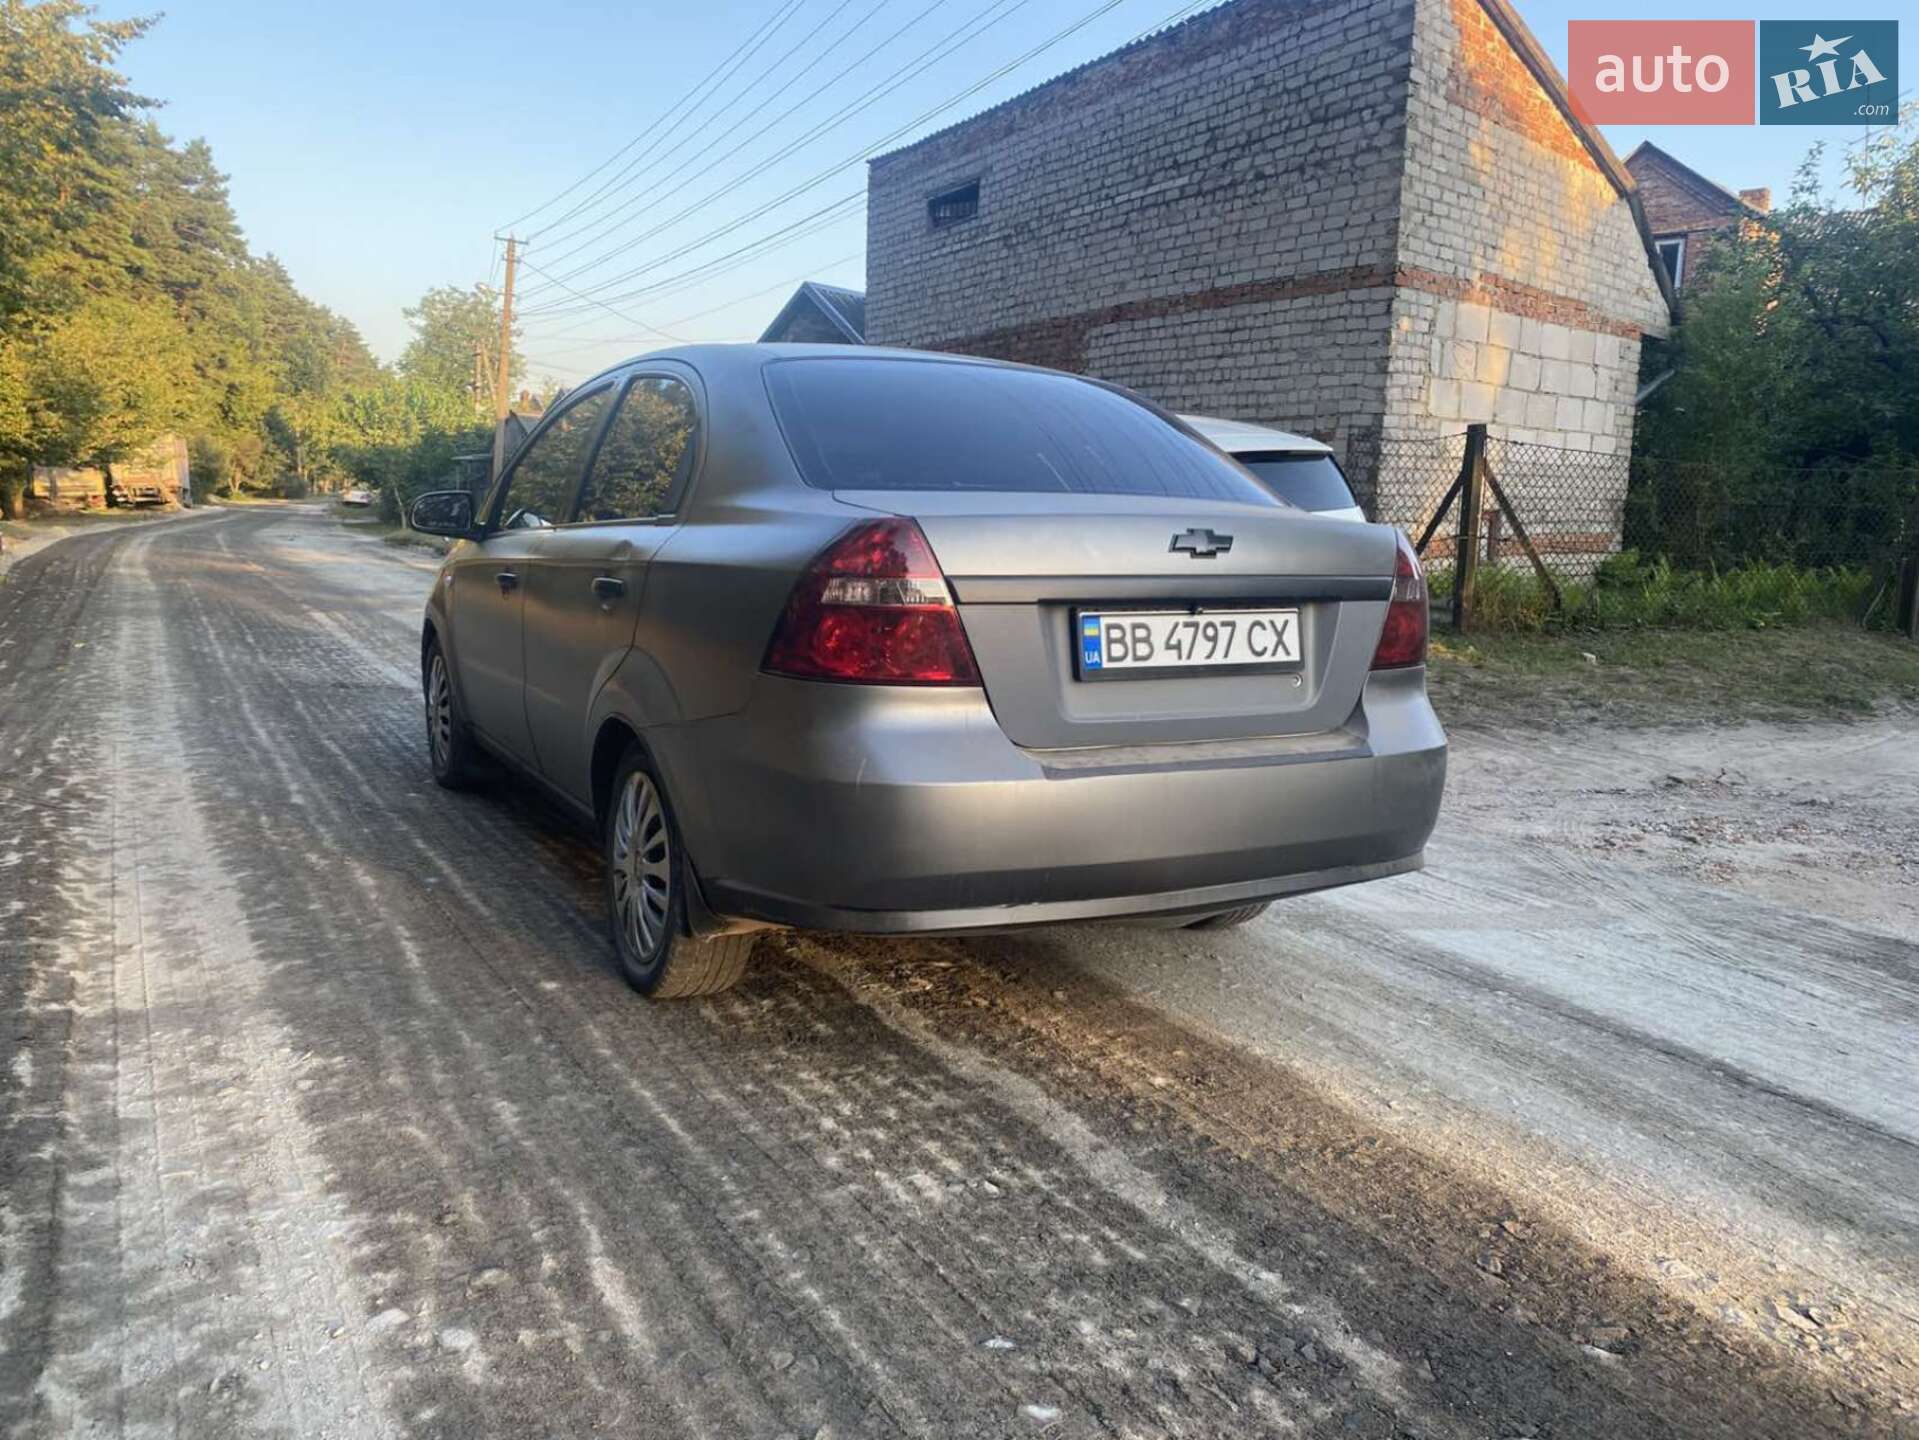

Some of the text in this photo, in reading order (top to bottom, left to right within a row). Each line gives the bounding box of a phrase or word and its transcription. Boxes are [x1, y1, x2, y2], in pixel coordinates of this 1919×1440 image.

[1104, 619, 1292, 663] BB 4797 CX
[1084, 651, 1100, 664] UA
